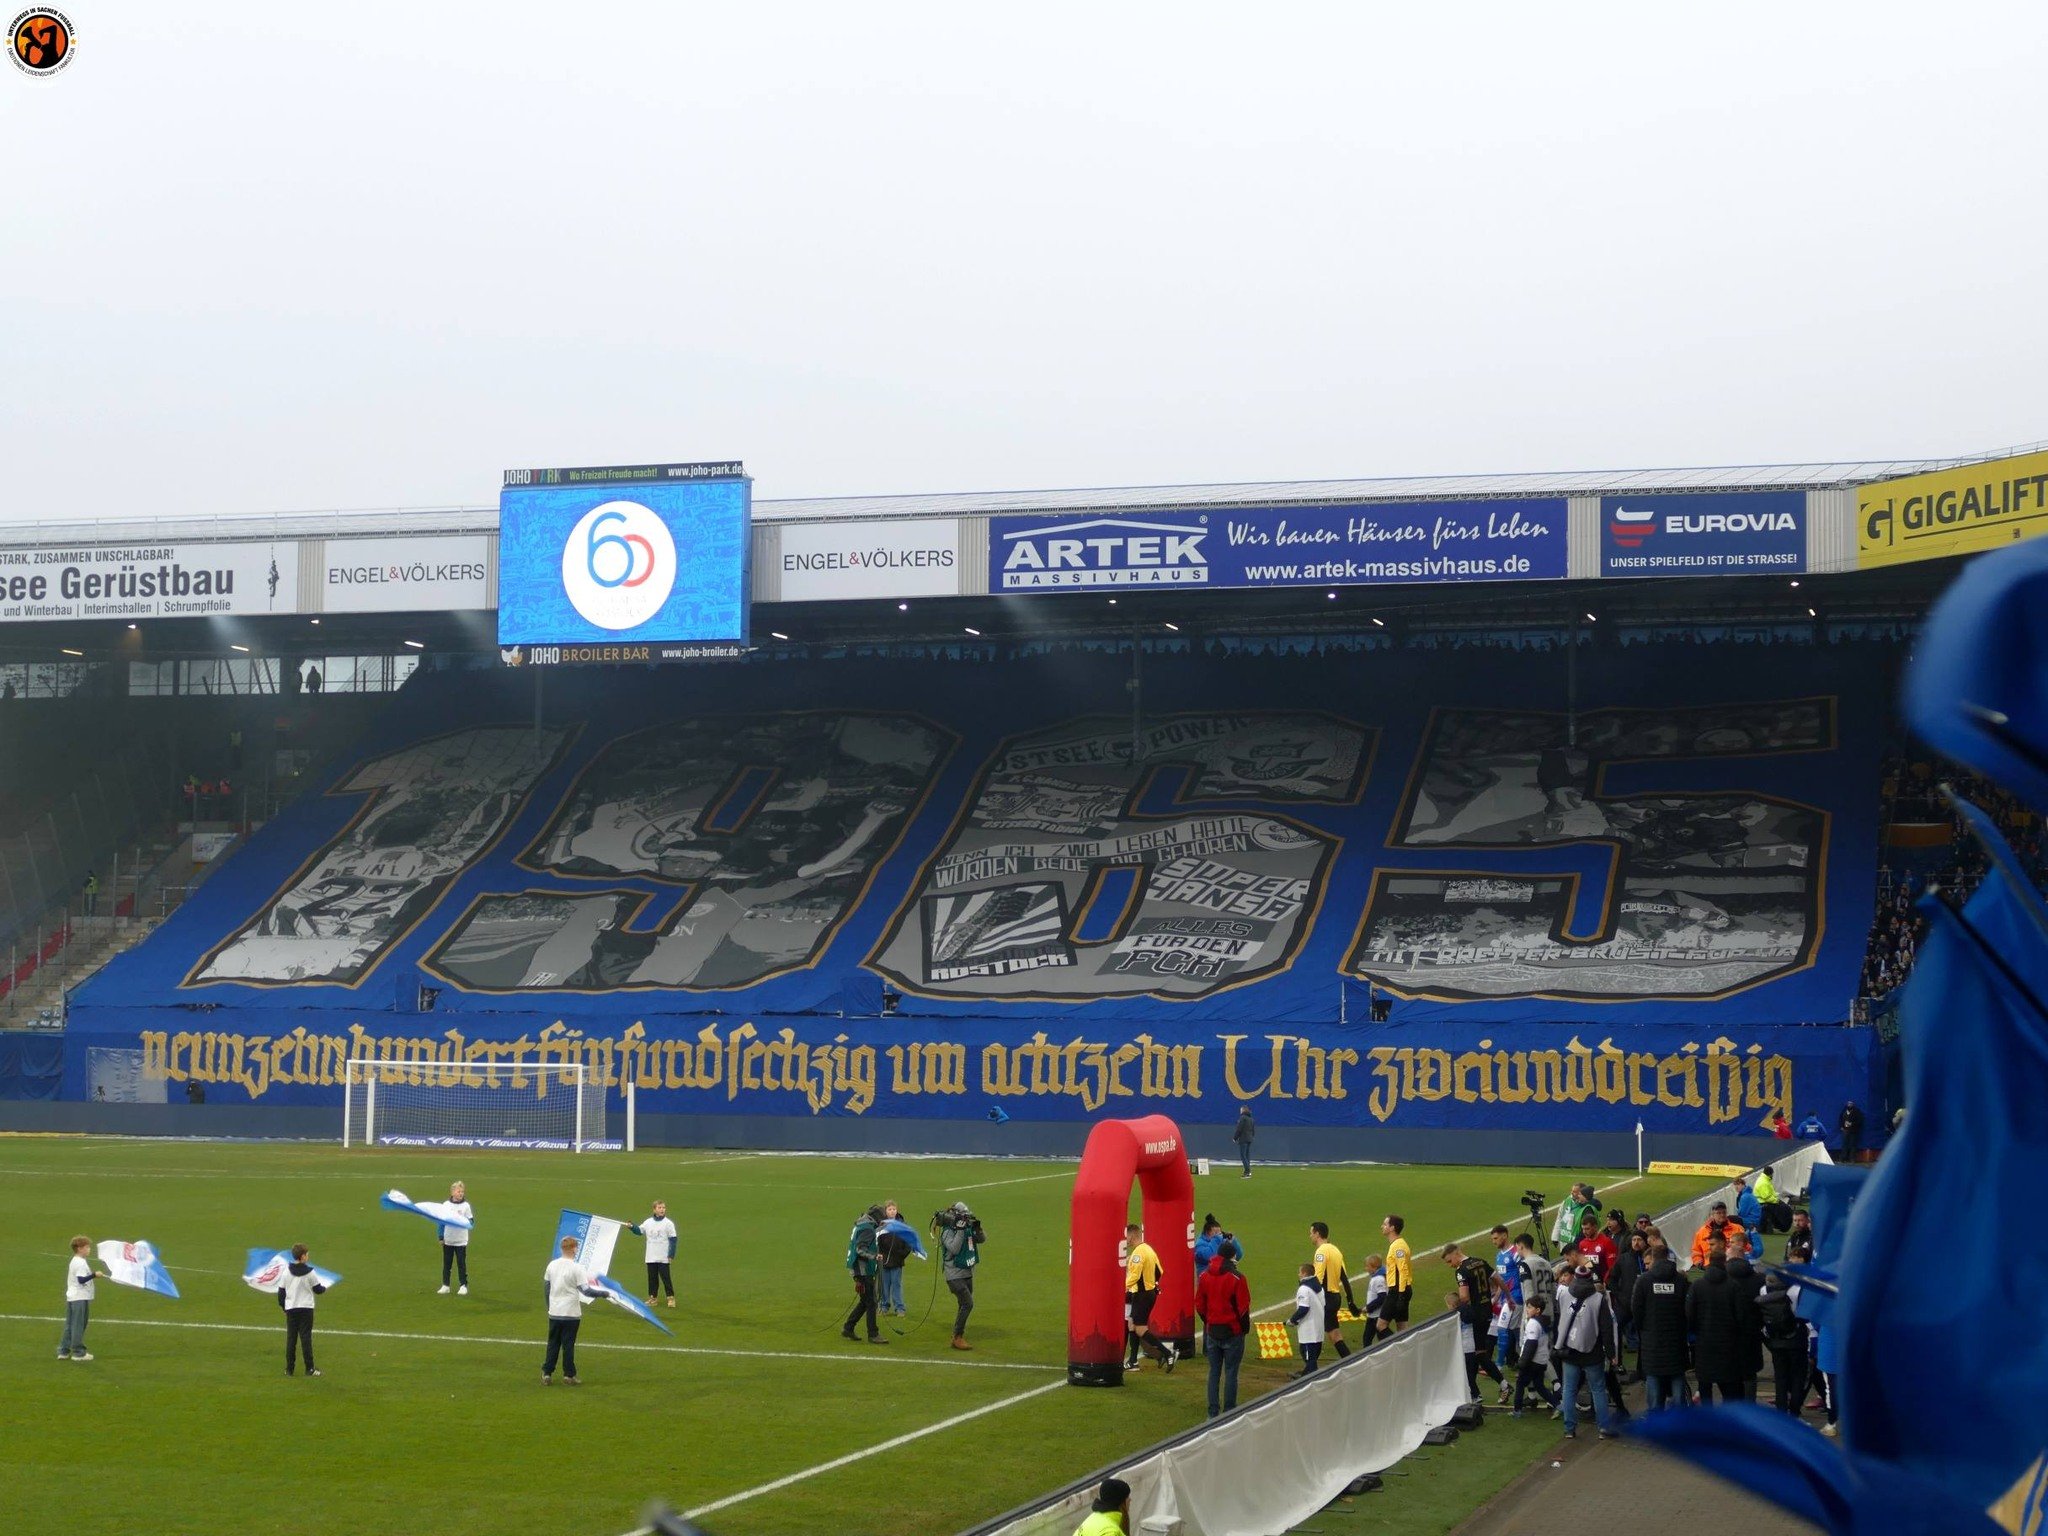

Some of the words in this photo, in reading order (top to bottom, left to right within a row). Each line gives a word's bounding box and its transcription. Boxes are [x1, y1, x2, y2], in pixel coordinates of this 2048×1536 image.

[504, 469, 531, 485] JOHO
[667, 463, 743, 479] www.joho-park.de
[1227, 519, 1271, 547] Wir
[1276, 521, 1341, 546] bauen
[1348, 517, 1426, 545] Häuser
[1431, 516, 1481, 553] fürs
[1488, 511, 1550, 540] Leben
[1665, 513, 1797, 534] EUROVIA
[34, 550, 92, 565] ZUSAMMEN
[95, 548, 175, 563] UNSCHLAGBAR!
[783, 547, 954, 572] ENGEL&VÖLKERS
[1004, 534, 1208, 570] ARTEK
[1610, 556, 1647, 569] UNSER
[1649, 555, 1705, 568] SPIELFELD
[1707, 554, 1725, 567] IST
[1727, 554, 1745, 566] DIE
[1746, 553, 1798, 566] STRASSE!
[328, 561, 486, 585] ENGEL&VÖLKERS
[1245, 554, 1531, 581] www.artek-massivhaus.de
[60, 563, 235, 600] Gerüstbau
[1008, 568, 1203, 586] MASSIVHAUS
[4, 604, 21, 617] und
[24, 603, 73, 617] Winterbau
[84, 601, 152, 616] Interimshallen
[164, 599, 232, 615] Schrumpffolie
[528, 646, 560, 665] JOHO
[562, 647, 620, 662] BROILER
[622, 646, 650, 661] BAR
[661, 646, 739, 660] www.joho-broiler.de
[885, 1040, 968, 1096] um
[981, 1030, 1204, 1111] achtzehn
[1216, 1033, 1360, 1102] Uhr
[1654, 1283, 1674, 1292] SLT
